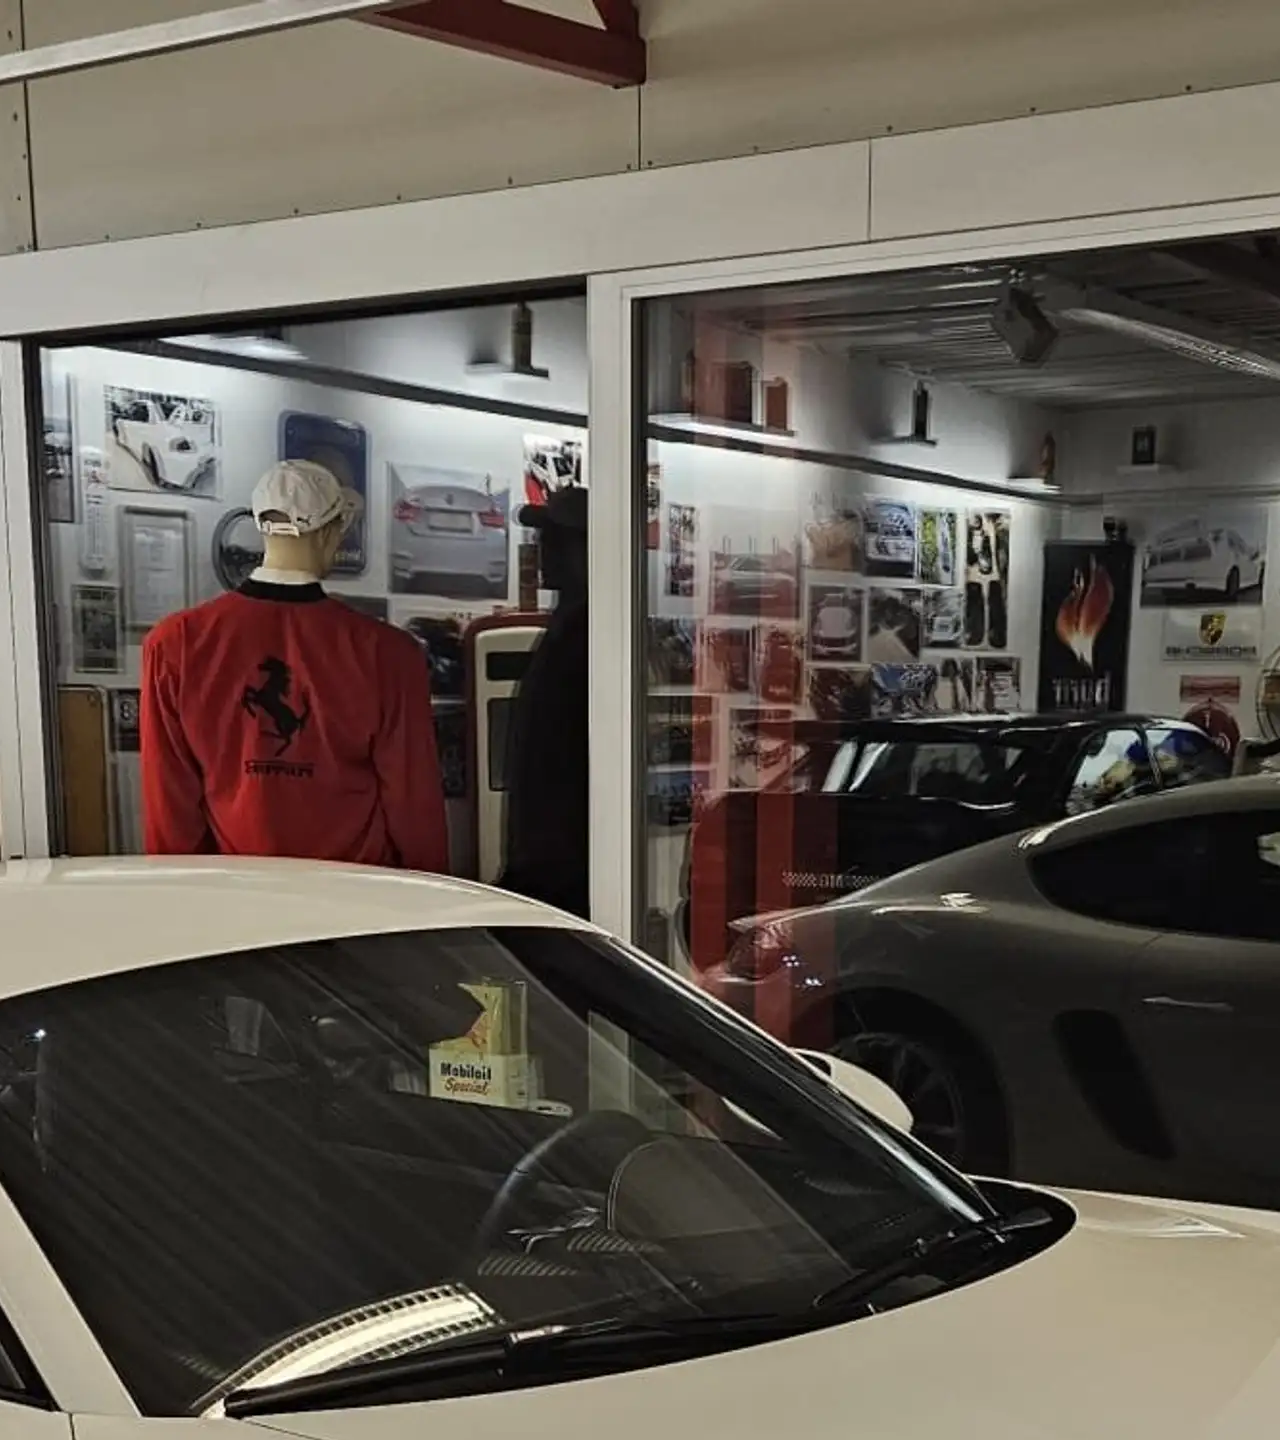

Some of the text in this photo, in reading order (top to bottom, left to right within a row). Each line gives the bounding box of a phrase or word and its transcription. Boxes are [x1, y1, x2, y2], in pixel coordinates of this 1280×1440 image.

[244, 760, 314, 778] Ferrari
[440, 1061, 492, 1081] Mobiloil
[443, 1077, 488, 1096] Special
